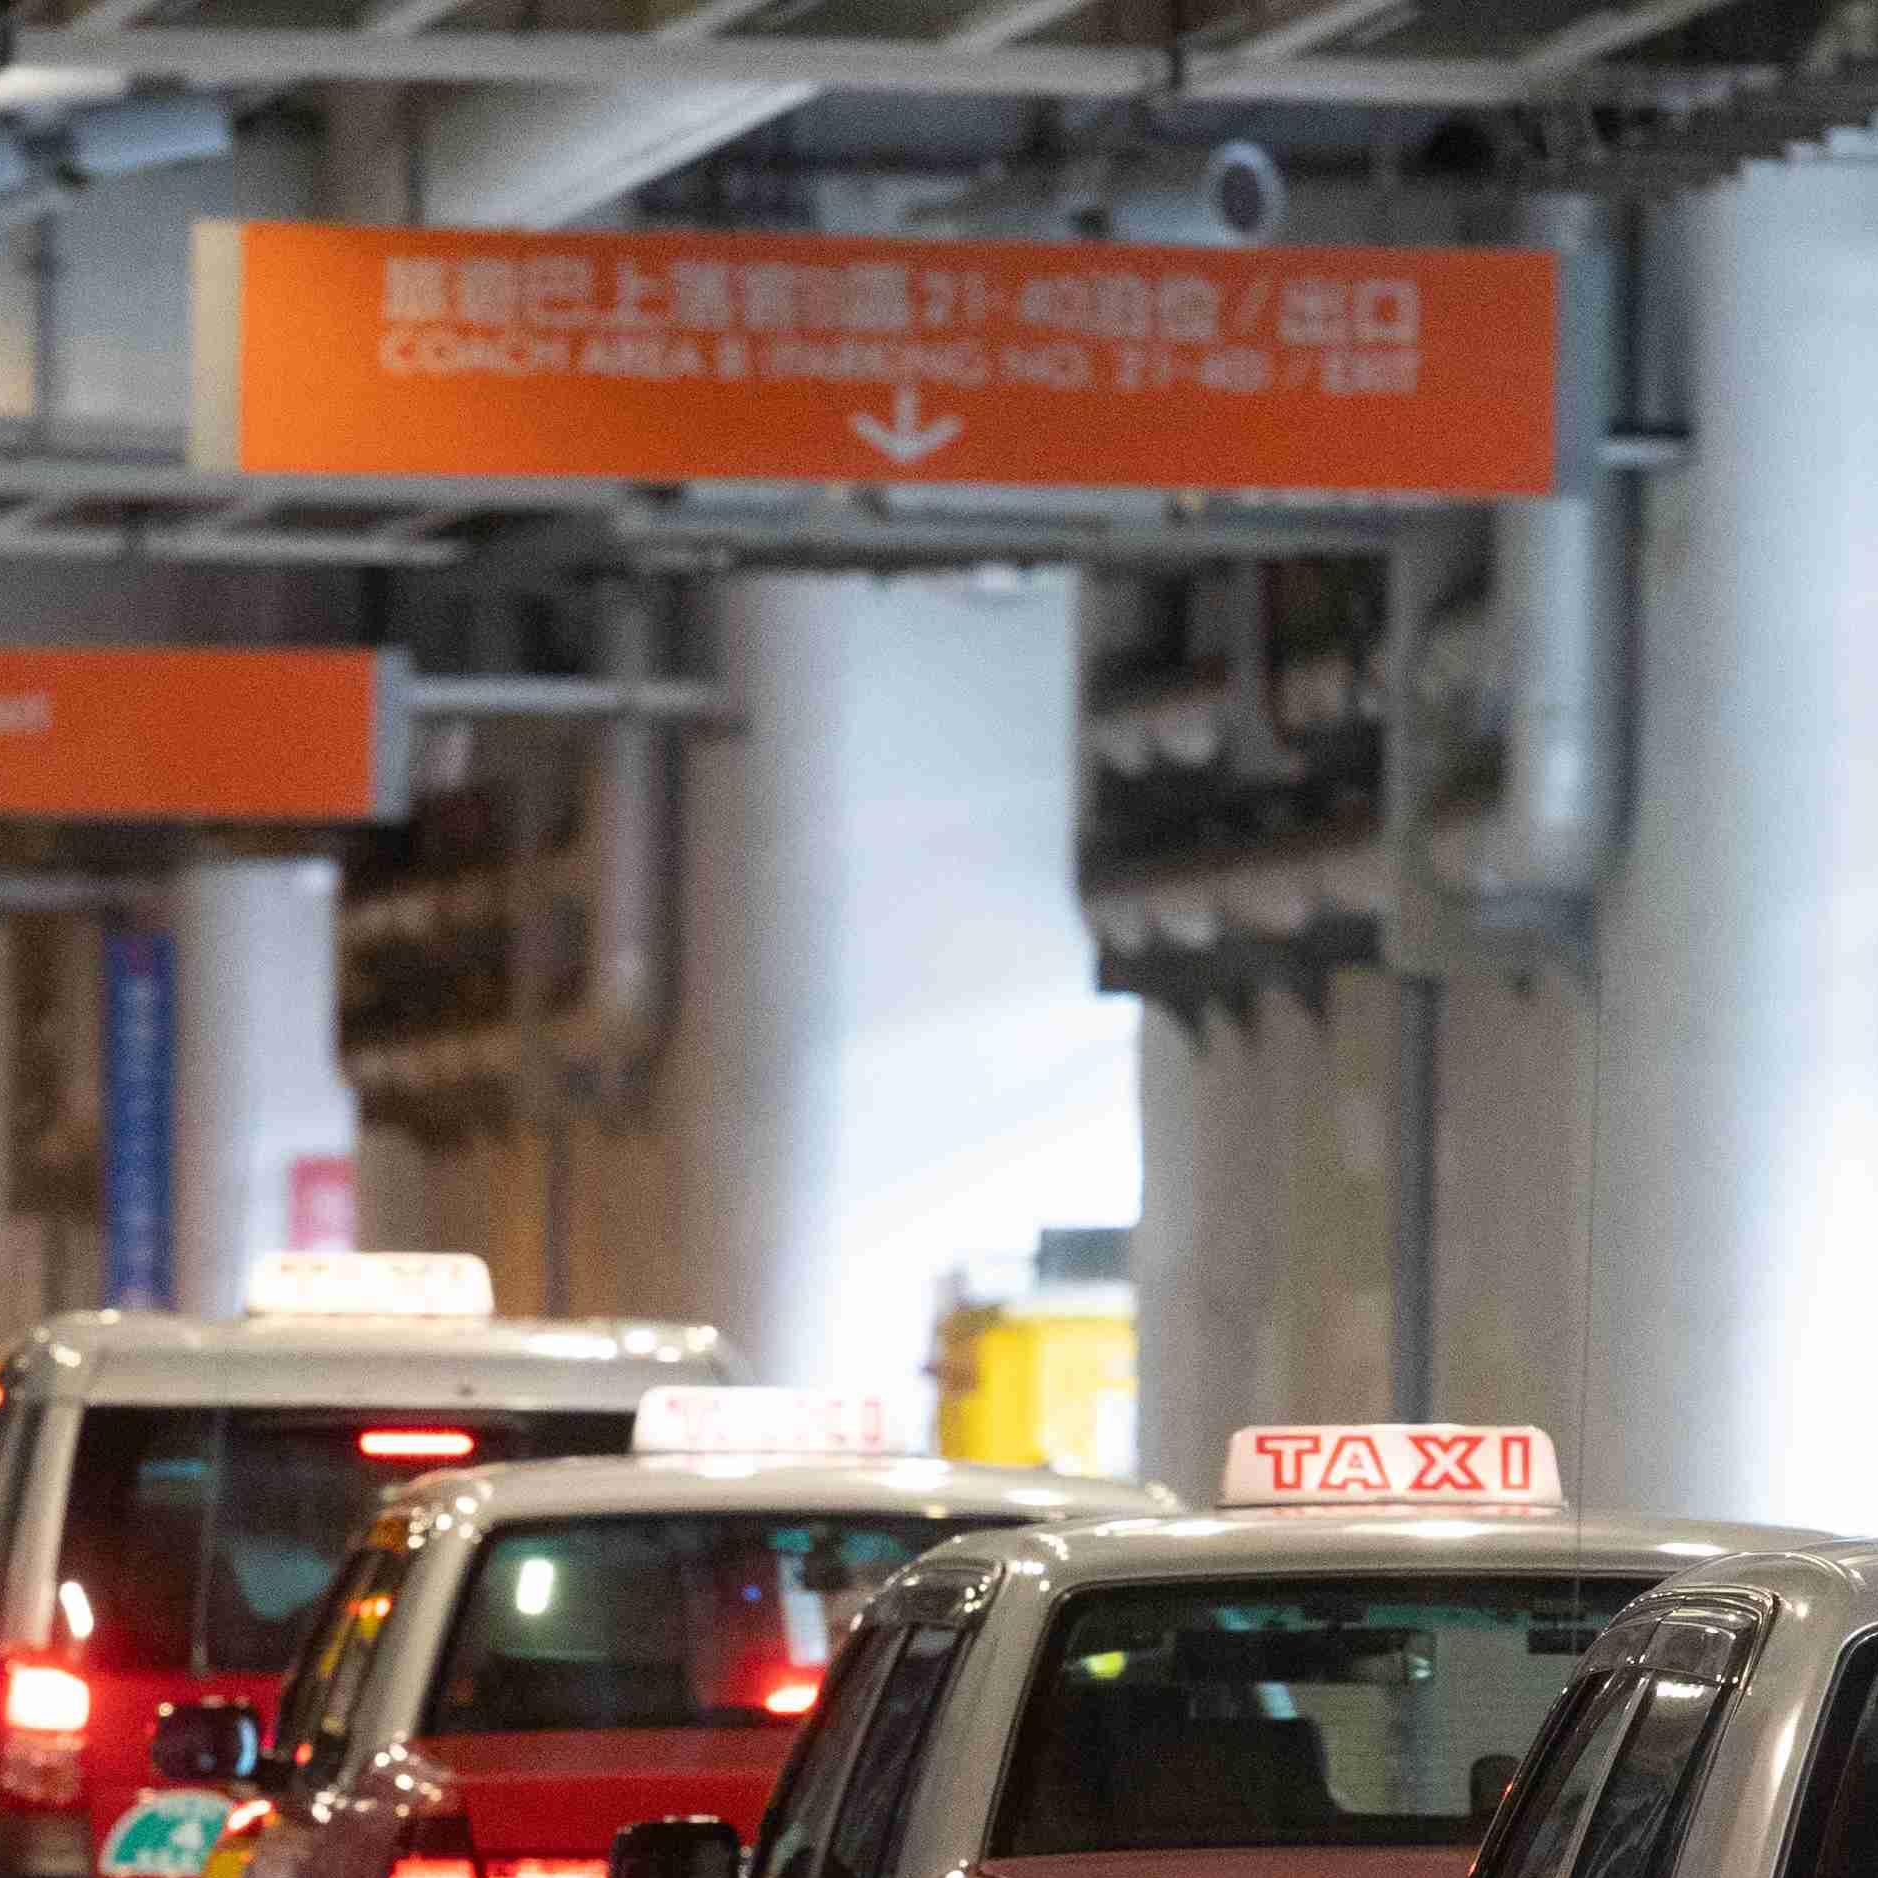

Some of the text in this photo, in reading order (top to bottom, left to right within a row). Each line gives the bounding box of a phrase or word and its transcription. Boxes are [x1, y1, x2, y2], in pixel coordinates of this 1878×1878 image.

[579, 337, 704, 376] AREA
[666, 1396, 883, 1444] TXI
[1256, 1435, 1530, 1490] TAXI
